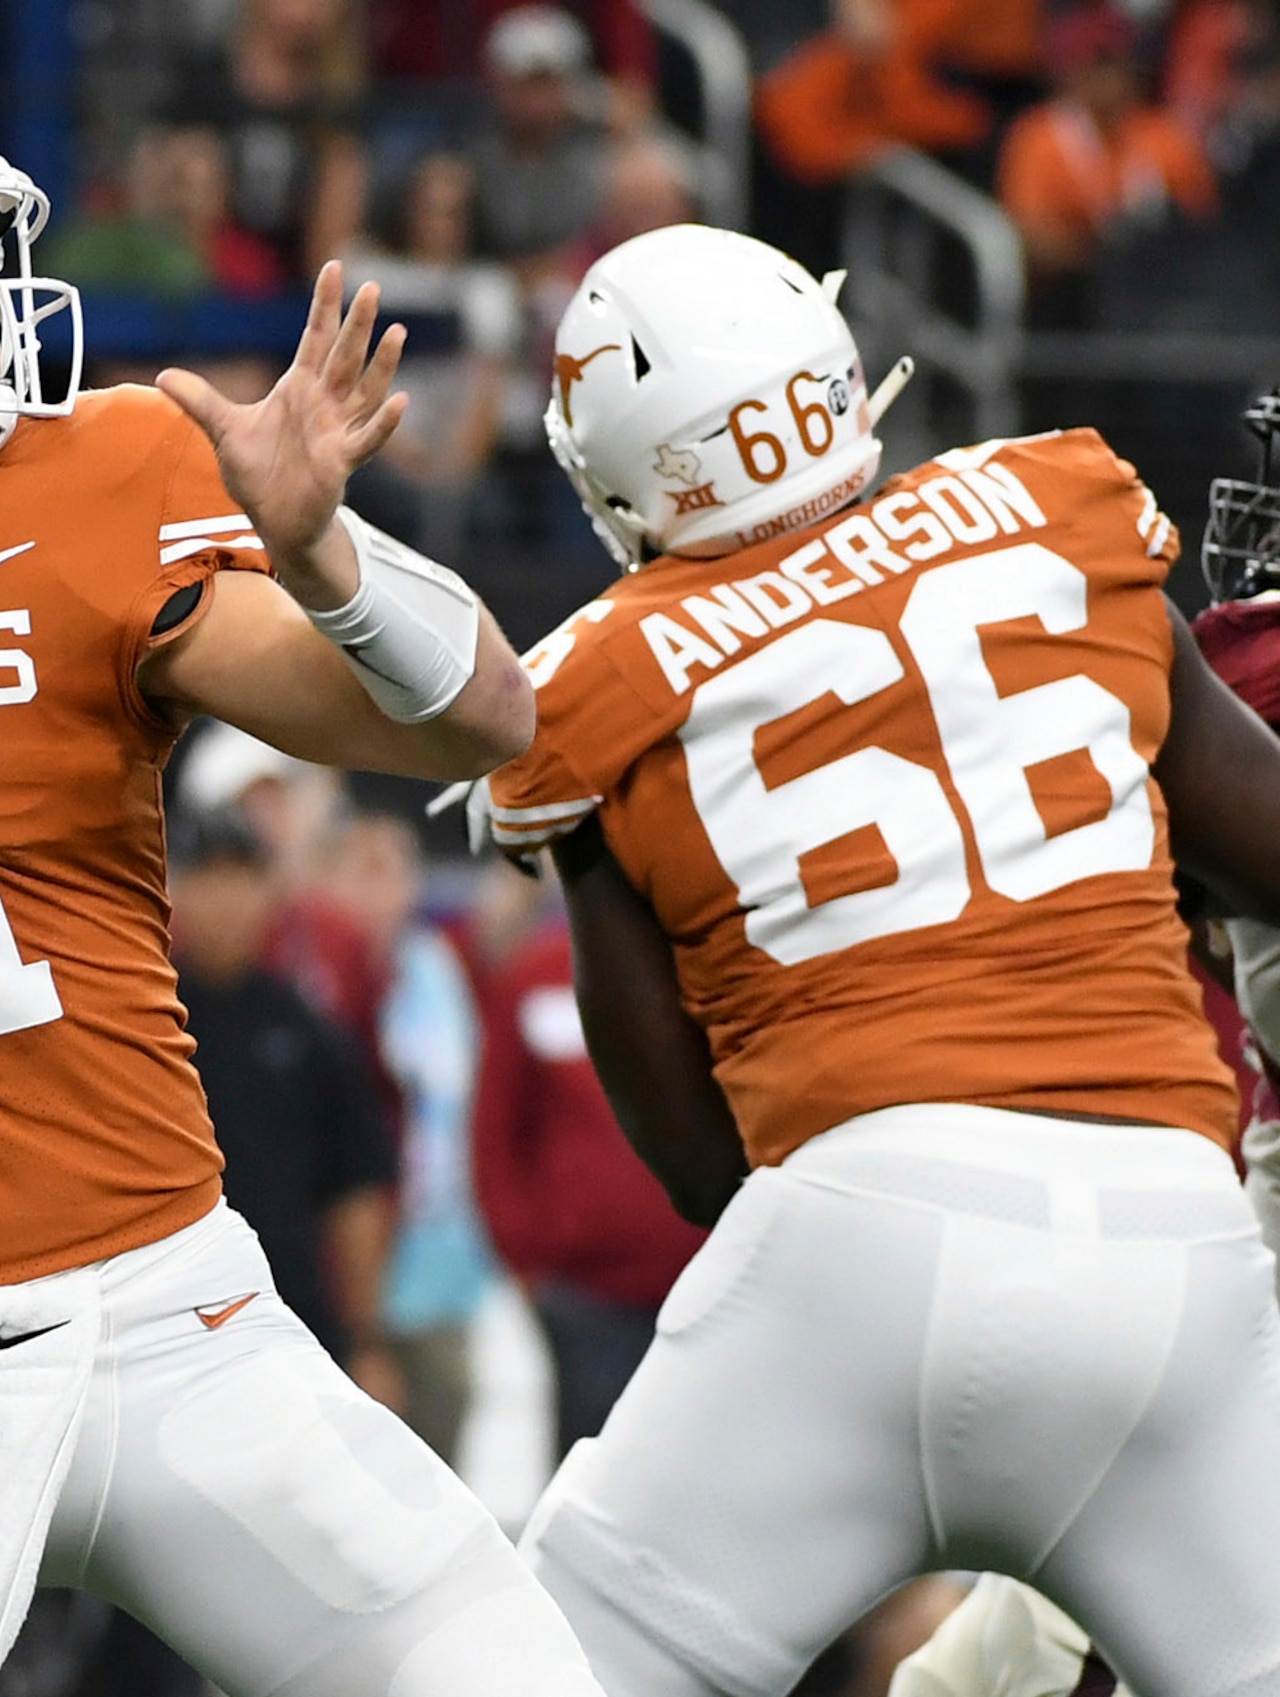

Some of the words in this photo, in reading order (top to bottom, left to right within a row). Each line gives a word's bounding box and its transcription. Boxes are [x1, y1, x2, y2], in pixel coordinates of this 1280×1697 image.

[728, 370, 834, 484] 66
[735, 466, 867, 548] LONGHORNS
[639, 462, 1047, 695] ANDERSON
[677, 543, 1156, 966] 66
